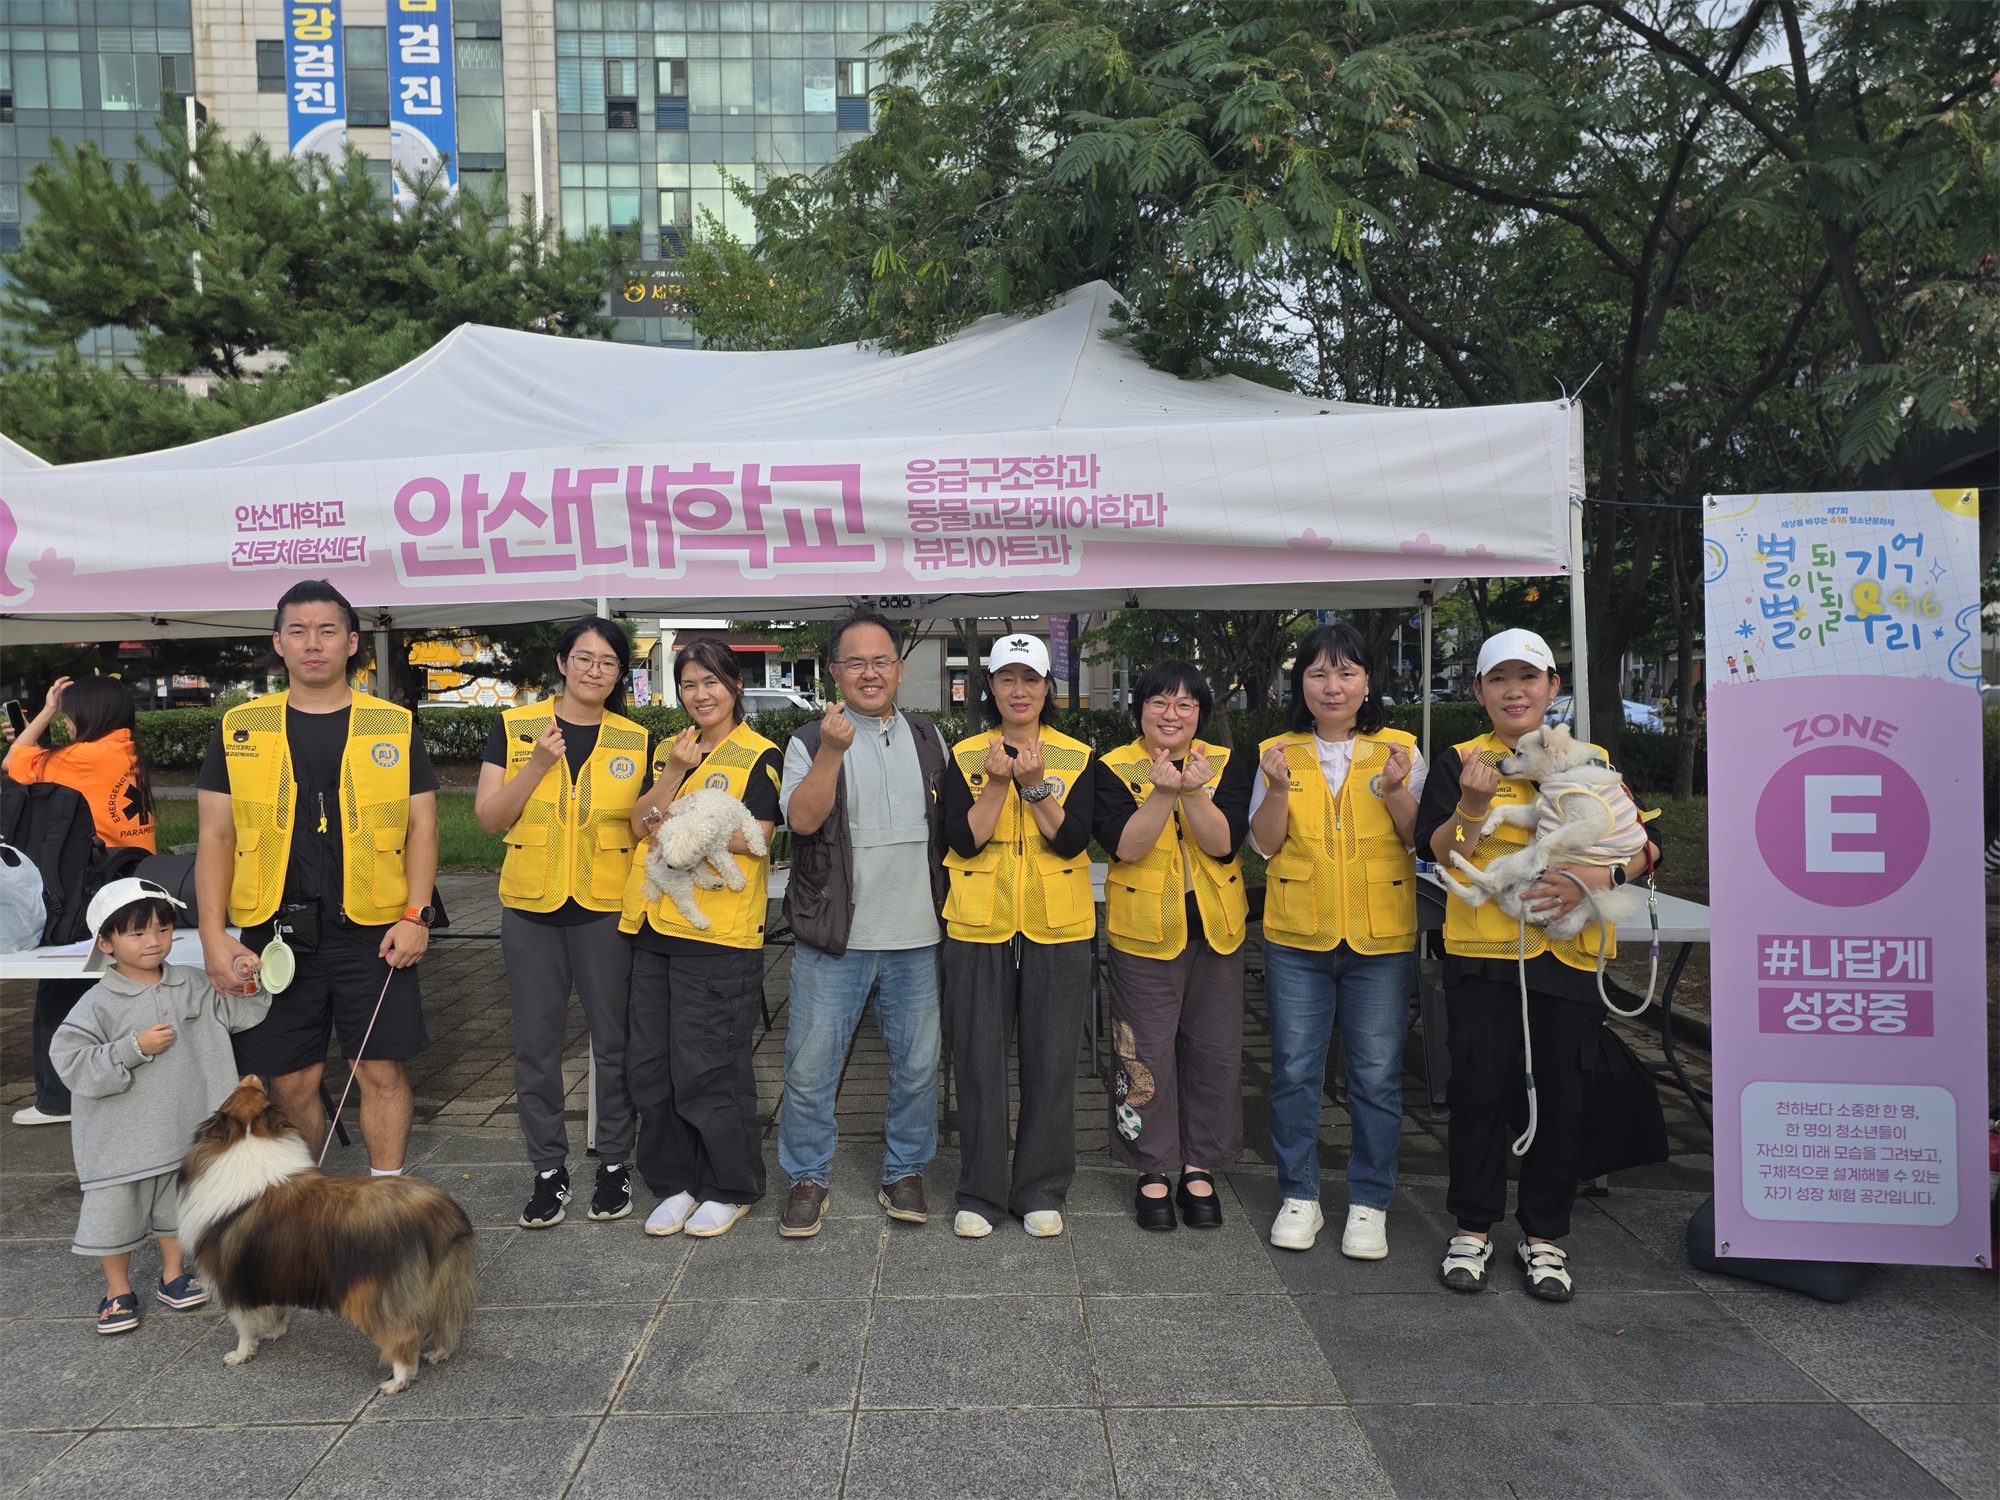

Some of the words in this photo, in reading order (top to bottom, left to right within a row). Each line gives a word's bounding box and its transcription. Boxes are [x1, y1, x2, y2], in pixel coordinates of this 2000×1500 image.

[292, 0, 337, 114] 강검진
[905, 453, 1101, 494] 응급구조학과
[234, 500, 346, 533] 안산대학교
[393, 462, 876, 578] 안산대학교
[907, 492, 1168, 533] 동물교감케어학과
[1781, 519, 1804, 529] 세상을
[1805, 517, 1829, 526] 바꾸는
[1848, 516, 1896, 527] 청소년문화제
[1827, 507, 1849, 515] 제7회
[231, 535, 367, 567] 진로체험센터
[913, 534, 1073, 571] 뷰티아트과
[1844, 532, 1925, 584] 기억
[1782, 713, 1900, 749] ZONE
[108, 772, 129, 824] EMERGENCY
[1804, 775, 1886, 873] E
[1763, 939, 1927, 980] #나답게
[1783, 991, 1909, 1034] 성장중
[1776, 1101, 1833, 1117] 천하보다
[1836, 1103, 1880, 1118] 소중한
[1883, 1104, 1897, 1119] 한
[1901, 1104, 1920, 1121] 명,
[1785, 1123, 1800, 1137] 한
[1804, 1123, 1832, 1138] 명의
[1835, 1124, 1907, 1140] 청소년들이
[1756, 1143, 1798, 1158] 자신의
[1802, 1144, 1831, 1159] 미래
[1834, 1145, 1877, 1161] 모습을
[1880, 1147, 1942, 1164] 그려보고,
[1758, 1164, 1829, 1180] 구체적으로
[1832, 1167, 1889, 1183] 설계해볼
[1893, 1169, 1908, 1184] 수
[1912, 1169, 1941, 1184] 있는
[1764, 1186, 1792, 1201] 자기
[1795, 1187, 1824, 1202] 성장
[1828, 1188, 1856, 1203] 체험
[1859, 1189, 1936, 1206] 공간입니다.
